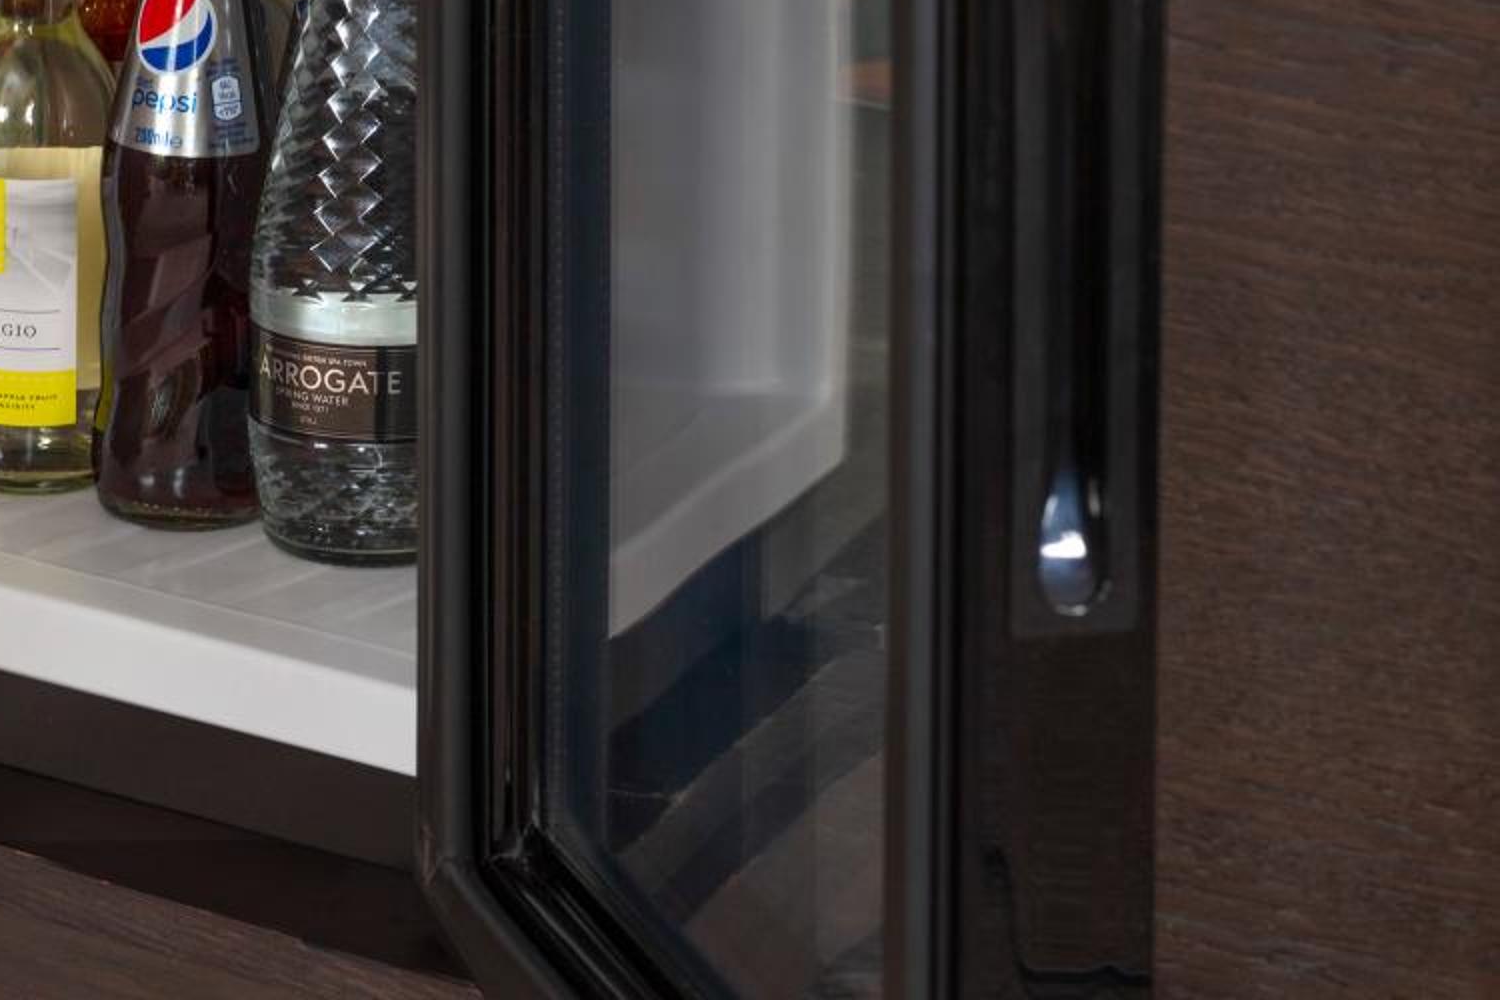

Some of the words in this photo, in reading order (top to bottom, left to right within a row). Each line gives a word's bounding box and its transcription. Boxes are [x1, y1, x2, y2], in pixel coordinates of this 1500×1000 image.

[131, 88, 197, 114] pepsi
[260, 351, 402, 396] ARROGATE
[311, 393, 349, 407] WATER
